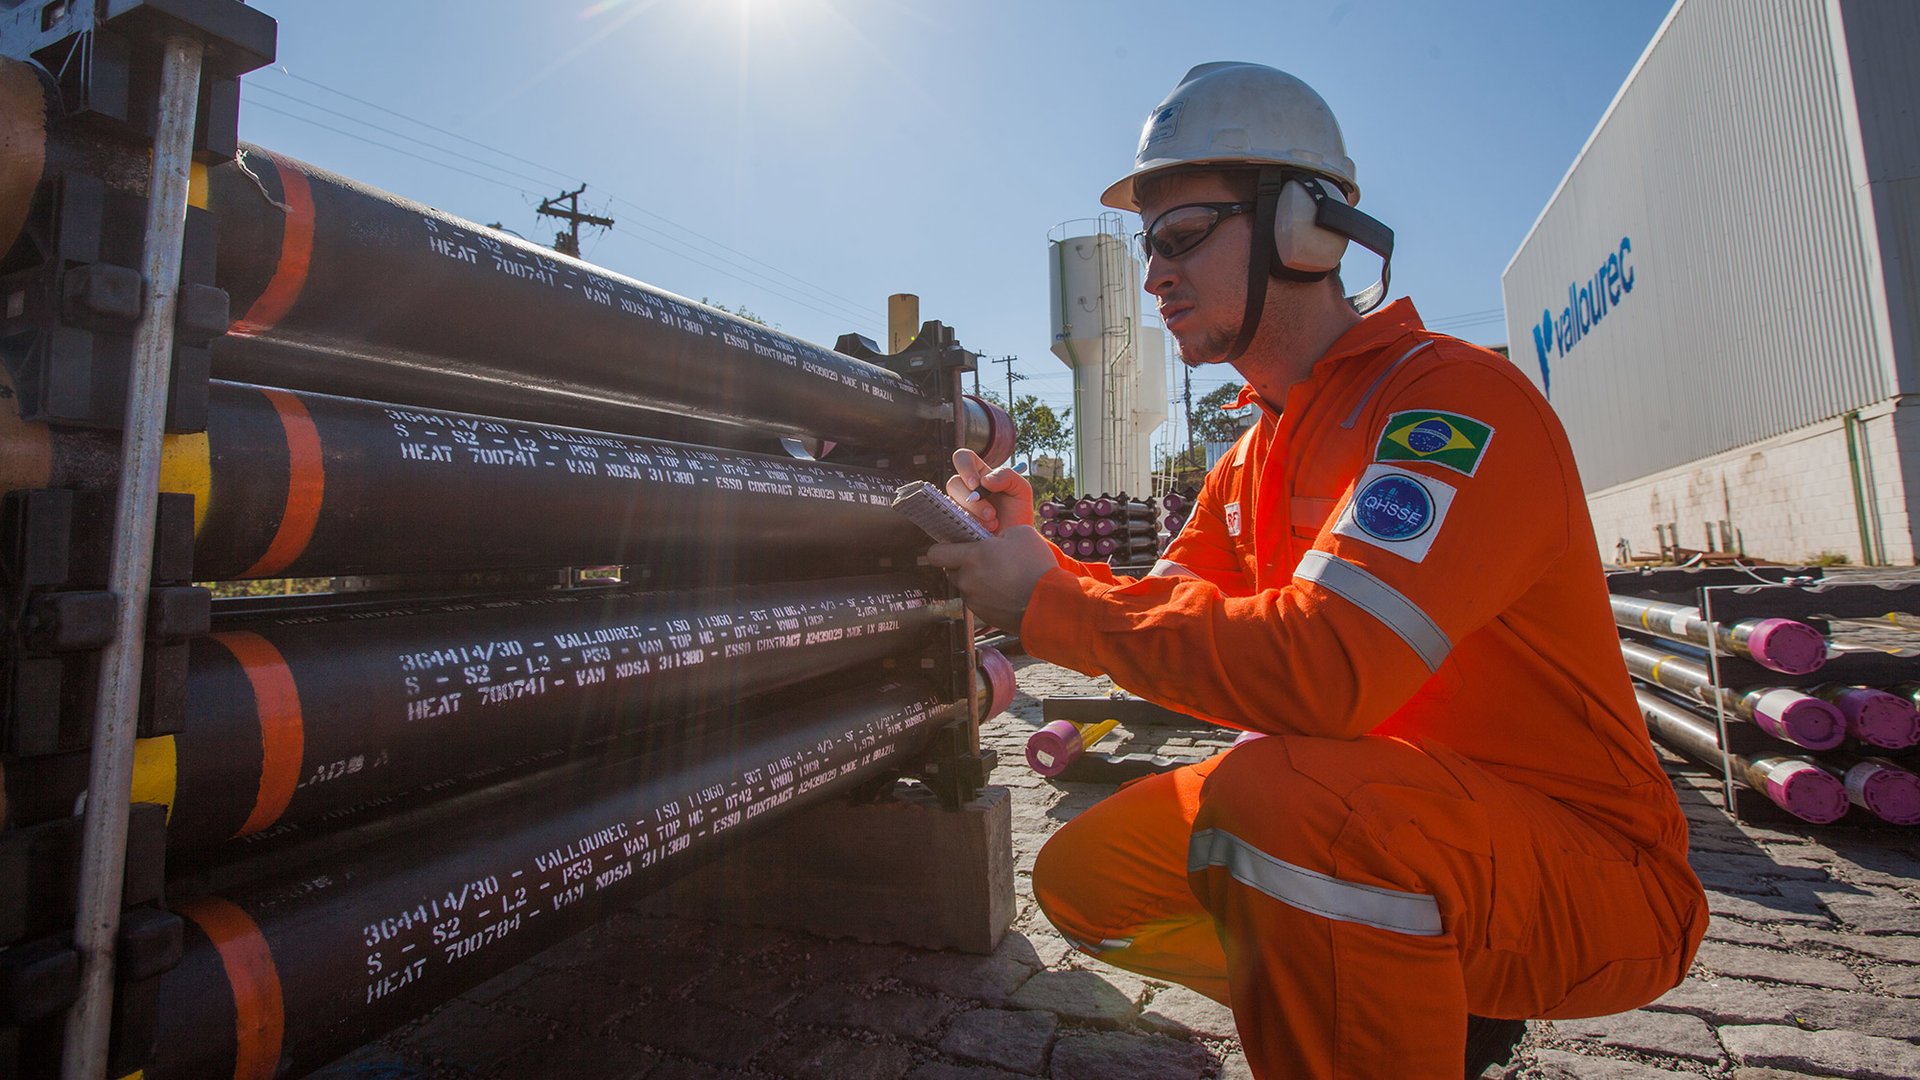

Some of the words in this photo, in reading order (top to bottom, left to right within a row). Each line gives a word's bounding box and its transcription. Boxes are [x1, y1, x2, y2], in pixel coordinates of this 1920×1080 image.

[424, 218, 438, 232] S
[478, 236, 503, 255] S2
[535, 256, 558, 273] L2
[668, 302, 690, 316] TOP
[1554, 236, 1634, 359] vallourec
[430, 236, 478, 264] HEAT
[492, 255, 554, 286] 700741
[583, 286, 611, 306] VAM
[620, 298, 654, 320] NDSA
[660, 310, 704, 336] 311380
[723, 332, 749, 350] ESSO
[754, 342, 797, 367] CONTRACT
[872, 386, 894, 402] BRAZIL
[384, 409, 508, 434] 364414/30
[538, 429, 627, 450] VALLOUREC
[394, 423, 409, 437] S
[452, 430, 480, 446] S2
[514, 437, 540, 452] L2
[568, 444, 599, 458] P53
[624, 452, 652, 464] VAM
[656, 455, 680, 468] TOP
[686, 459, 703, 470] HC
[722, 464, 750, 476] DT42
[401, 442, 452, 462] HEAT
[467, 448, 536, 467] 700741
[566, 458, 597, 476] VAM
[605, 464, 642, 480] NDSA
[649, 468, 695, 484] 311380
[716, 476, 742, 490] ESSO
[748, 480, 793, 496] CONTRACT
[838, 491, 855, 502] MADE
[1365, 496, 1422, 526] QHSSE
[399, 641, 523, 671] 364414/30
[554, 626, 642, 649] VALLOUREC
[666, 620, 690, 634] ISO
[698, 614, 732, 629] 11960
[820, 600, 836, 612] 4/3
[405, 676, 420, 695] S
[464, 664, 491, 684] S2
[526, 655, 551, 674] L2
[582, 647, 612, 664] P53
[638, 639, 664, 654] VAM
[669, 634, 692, 649] TOP
[699, 630, 715, 645] HC
[734, 624, 760, 639] DT42
[889, 602, 904, 612] PIPE
[408, 692, 461, 721] HEAT
[478, 676, 545, 705] 700741
[576, 666, 606, 686] VAM
[616, 659, 650, 679] NDSA
[659, 649, 704, 670] 311380
[725, 642, 751, 658] ESSO
[756, 633, 801, 652] CONTRACT
[846, 625, 863, 638] MADE
[878, 620, 900, 632] BRAZIL
[364, 876, 499, 947] 364414/30
[535, 823, 628, 873] VALLOUREC
[656, 801, 680, 822] ISO
[688, 783, 724, 808] 11960
[818, 739, 833, 754] 4/3
[904, 702, 923, 716] 17.00
[367, 952, 382, 975] S
[432, 917, 460, 944] S2
[502, 887, 527, 913] L2
[562, 858, 592, 885] P53
[624, 833, 649, 857] VAM
[656, 819, 680, 841] TOP
[688, 809, 704, 828] HC
[725, 788, 752, 810] DT42
[799, 759, 820, 778] 13CR
[887, 722, 902, 736] PIPE
[904, 712, 926, 729] NUMBER
[367, 958, 426, 1004] HEAT
[445, 912, 520, 964] 700784
[553, 883, 584, 910] VAM
[596, 861, 632, 891] NDSA
[642, 833, 690, 868] 311380
[713, 810, 740, 835] ESSO
[746, 786, 794, 820] CONTRACT
[840, 759, 858, 776] MADE
[872, 744, 896, 761] BRAZIL
